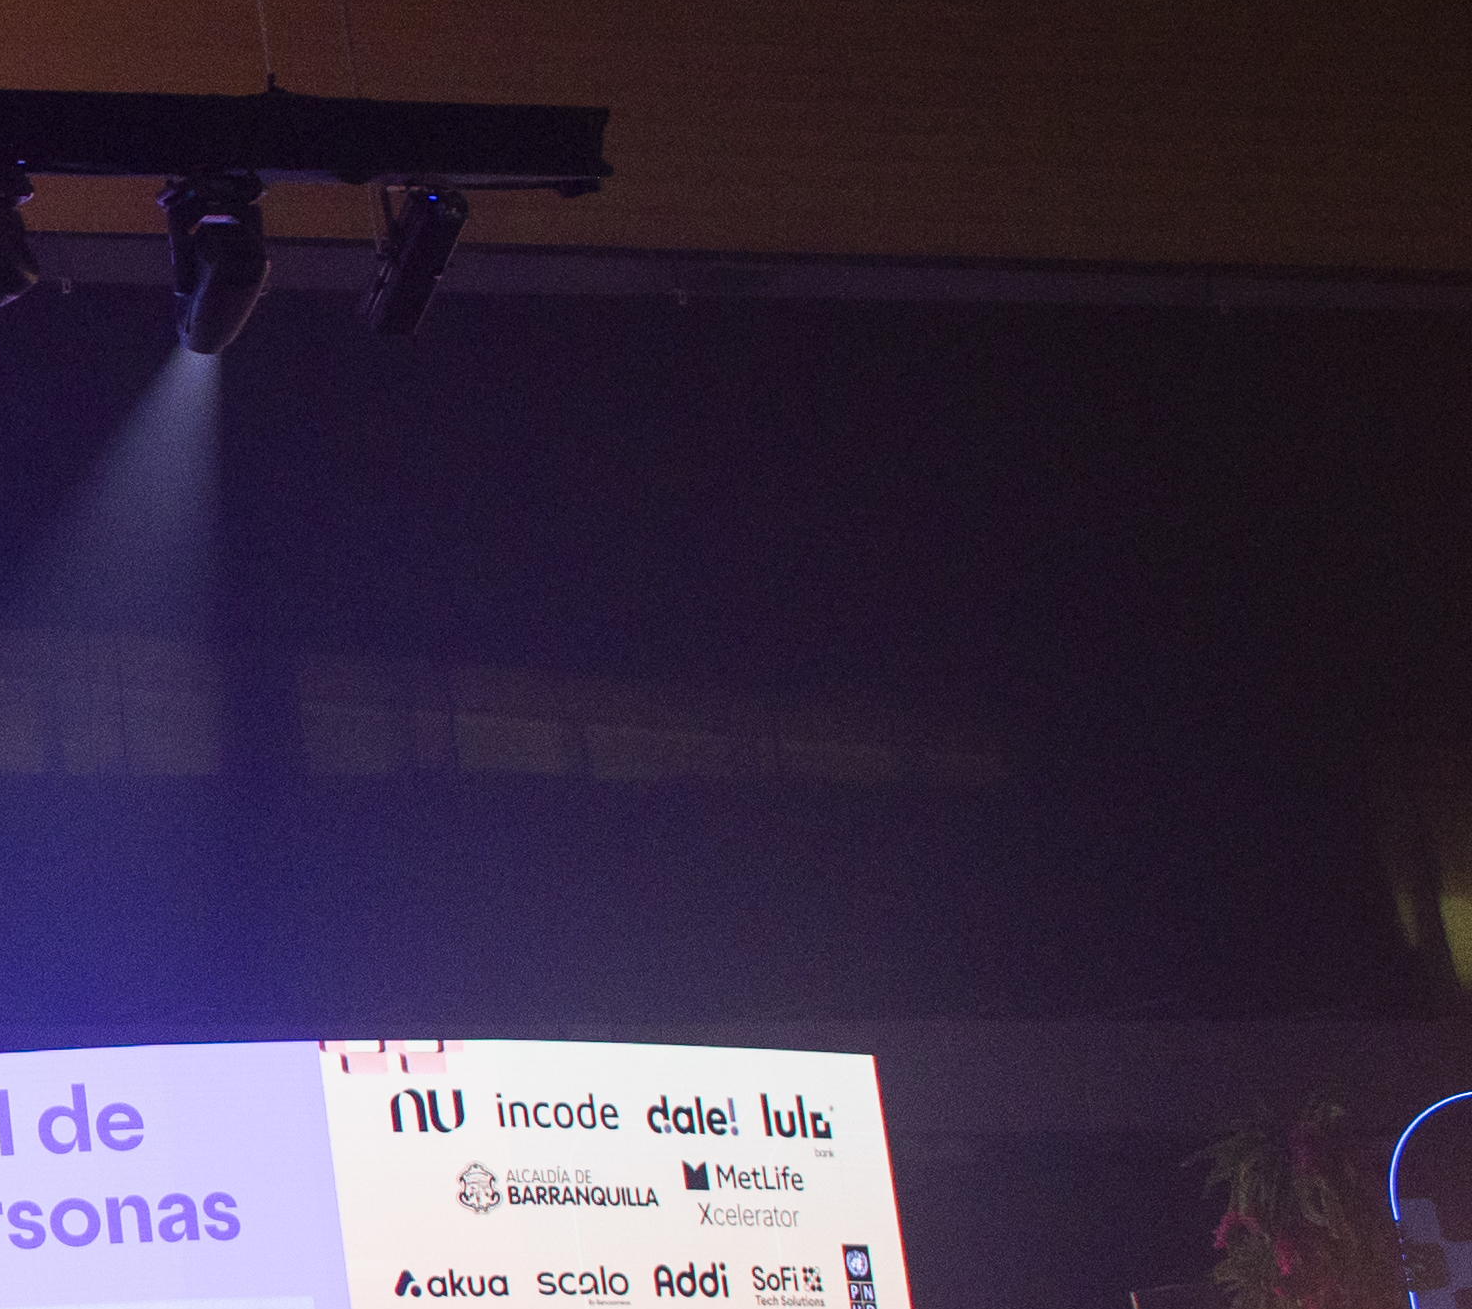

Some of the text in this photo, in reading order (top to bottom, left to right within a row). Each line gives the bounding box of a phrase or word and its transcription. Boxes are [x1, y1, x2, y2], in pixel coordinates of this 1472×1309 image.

[38, 1083, 144, 1155] de
[496, 1093, 619, 1130] incode
[647, 1095, 738, 1136] dale!
[506, 1169, 592, 1184] ALCALDÍA DE
[716, 1164, 804, 1191] MetLife
[507, 1185, 659, 1207] BARRANQUILLA
[697, 1202, 799, 1228] Xcelerator
[427, 1269, 509, 1297] akua
[537, 1266, 629, 1296] scalo
[654, 1262, 729, 1298] Addi
[752, 1266, 799, 1291] SoFi
[755, 1294, 826, 1307] Tech Solutions
